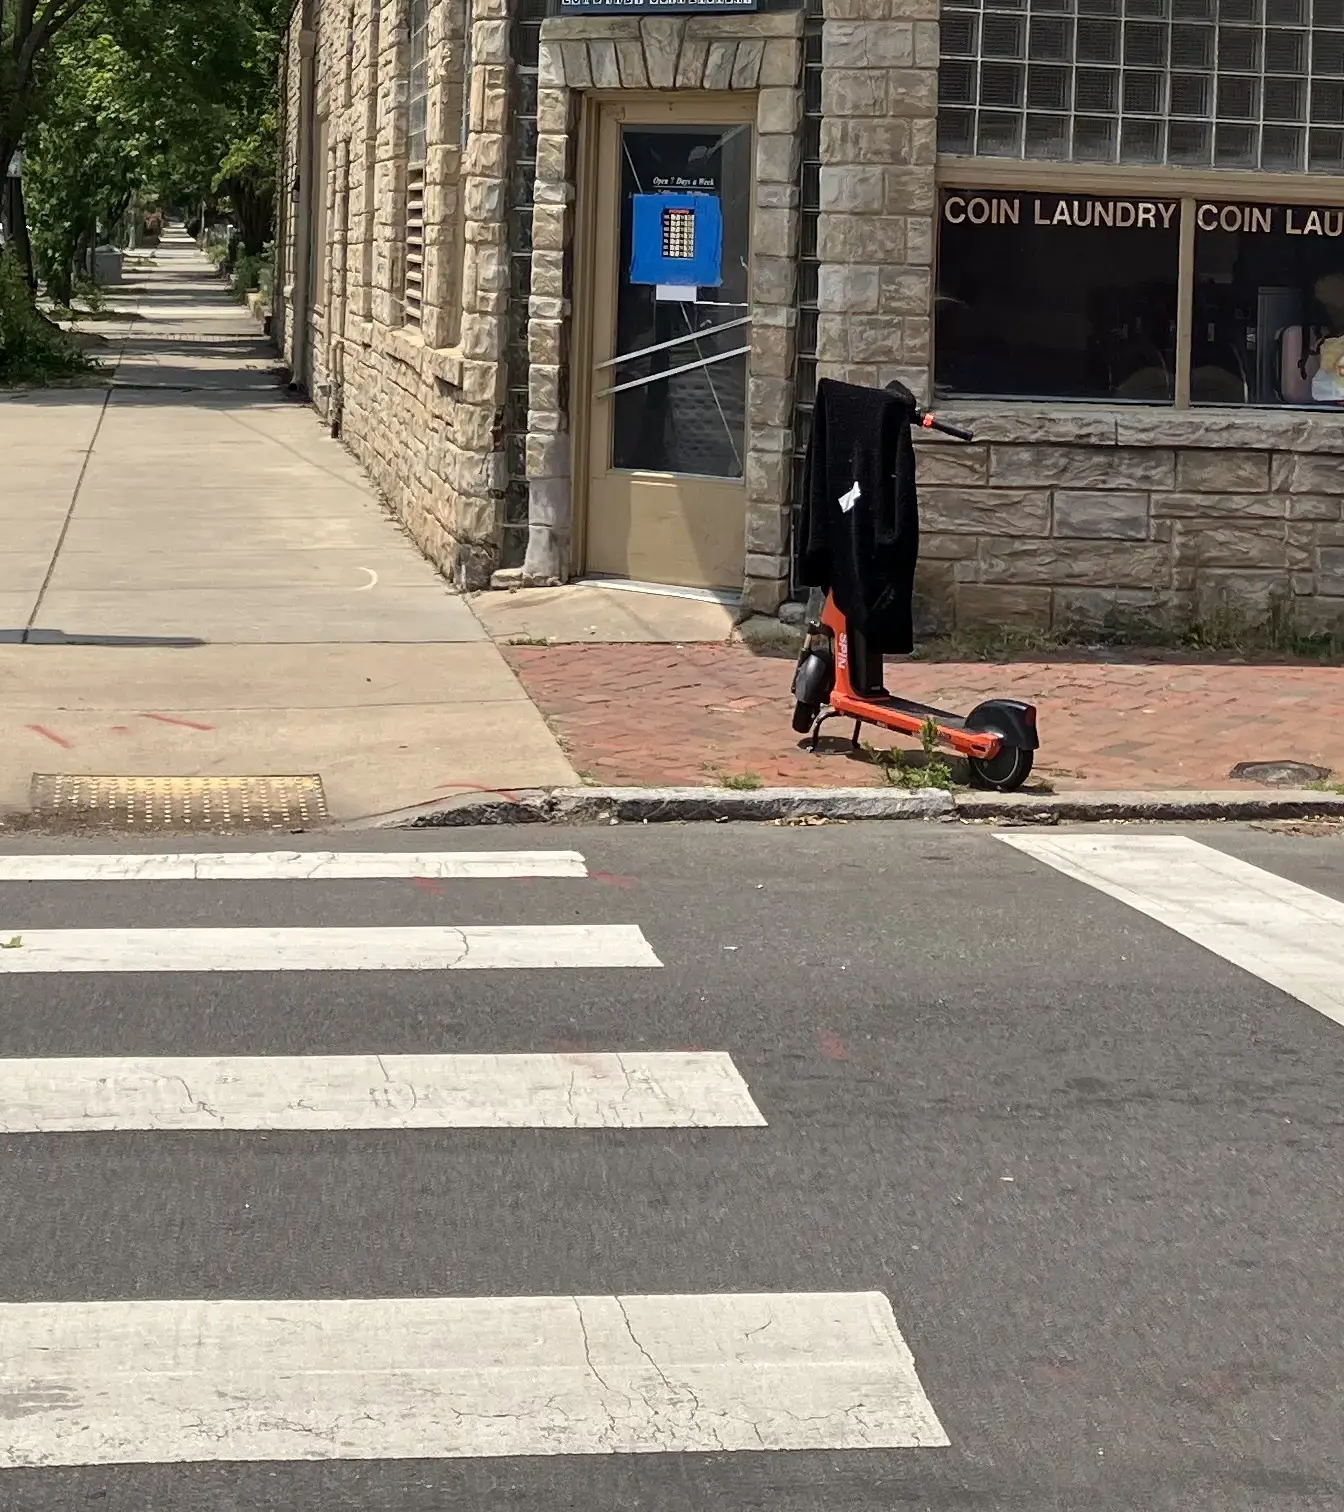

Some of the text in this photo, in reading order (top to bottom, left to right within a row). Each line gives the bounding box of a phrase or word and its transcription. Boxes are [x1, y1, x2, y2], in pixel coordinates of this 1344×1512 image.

[653, 176, 669, 185] Open
[676, 177, 691, 186] Days
[699, 177, 714, 185] Week
[945, 196, 1177, 229] COIN LAUNDRY
[1197, 203, 1271, 233] COIN
